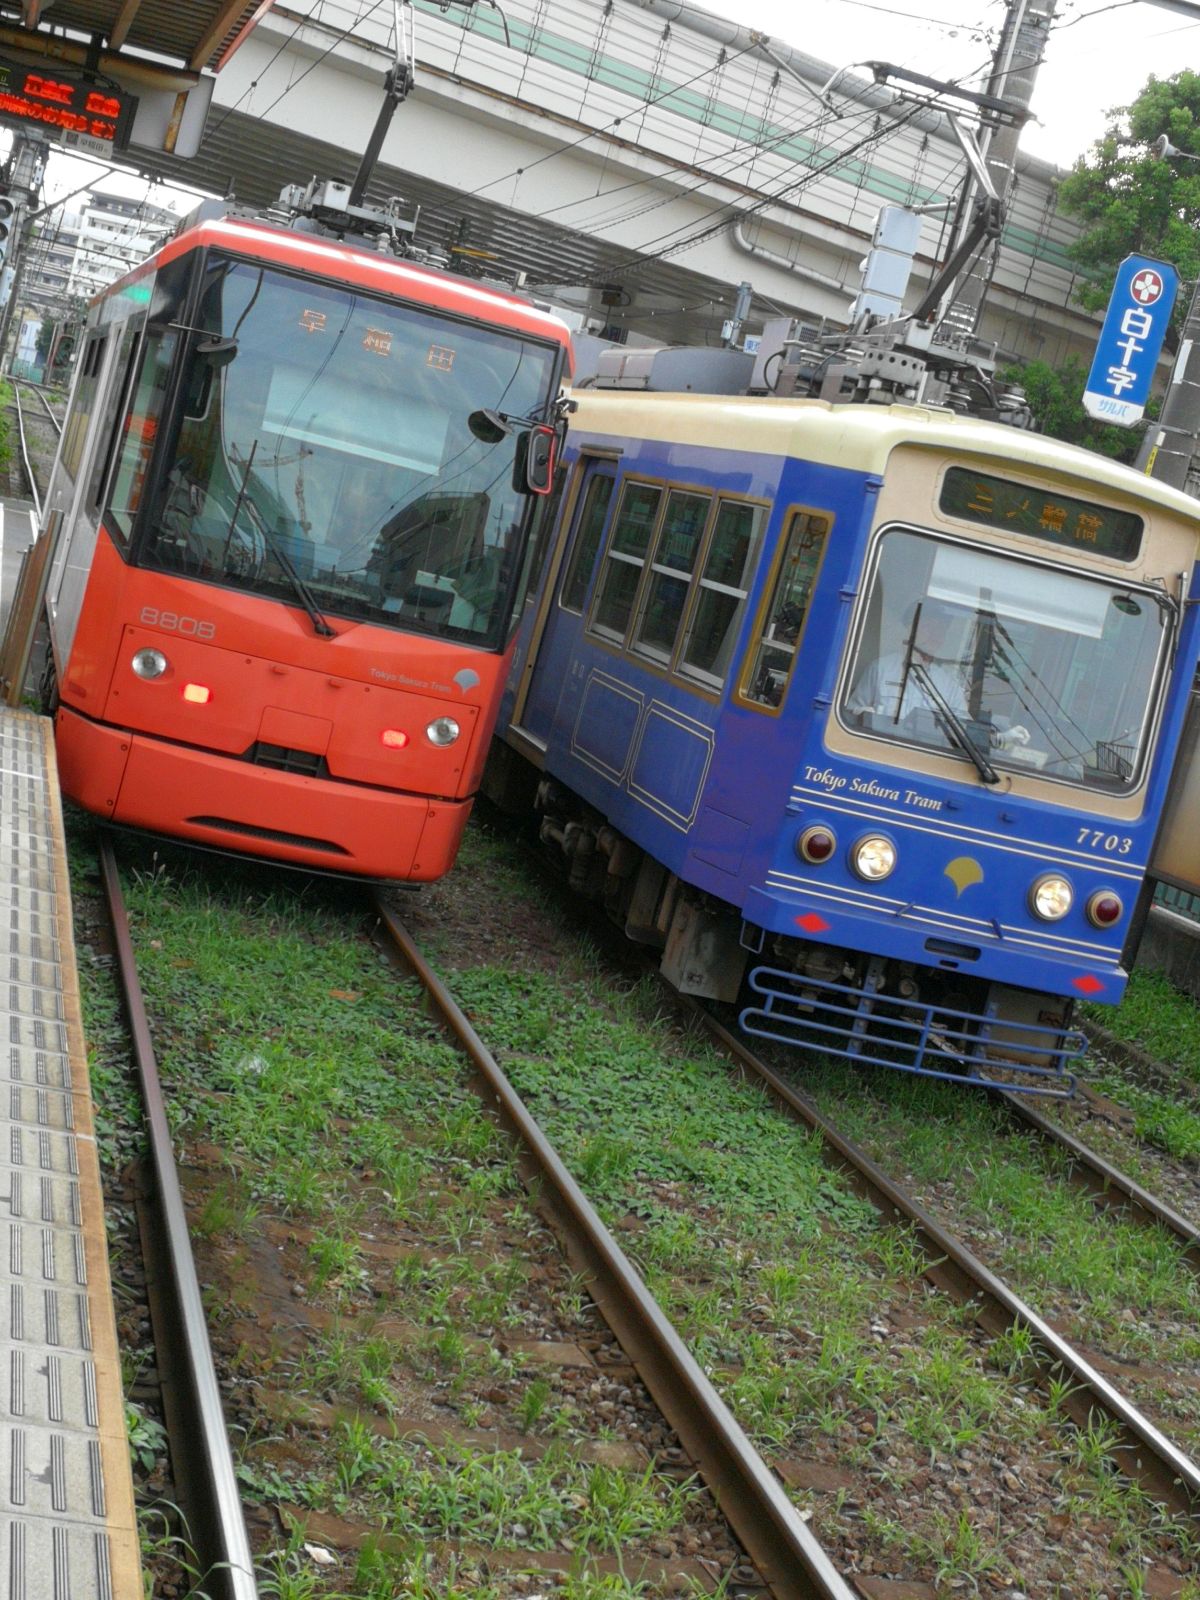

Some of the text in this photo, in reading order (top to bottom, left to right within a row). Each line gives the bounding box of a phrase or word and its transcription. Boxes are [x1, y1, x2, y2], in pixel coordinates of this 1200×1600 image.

[1106, 307, 1153, 396] 白十字
[140, 606, 216, 640] 8808
[804, 766, 943, 811] Tokyo Sakura Tram
[1077, 827, 1133, 854] 7703
